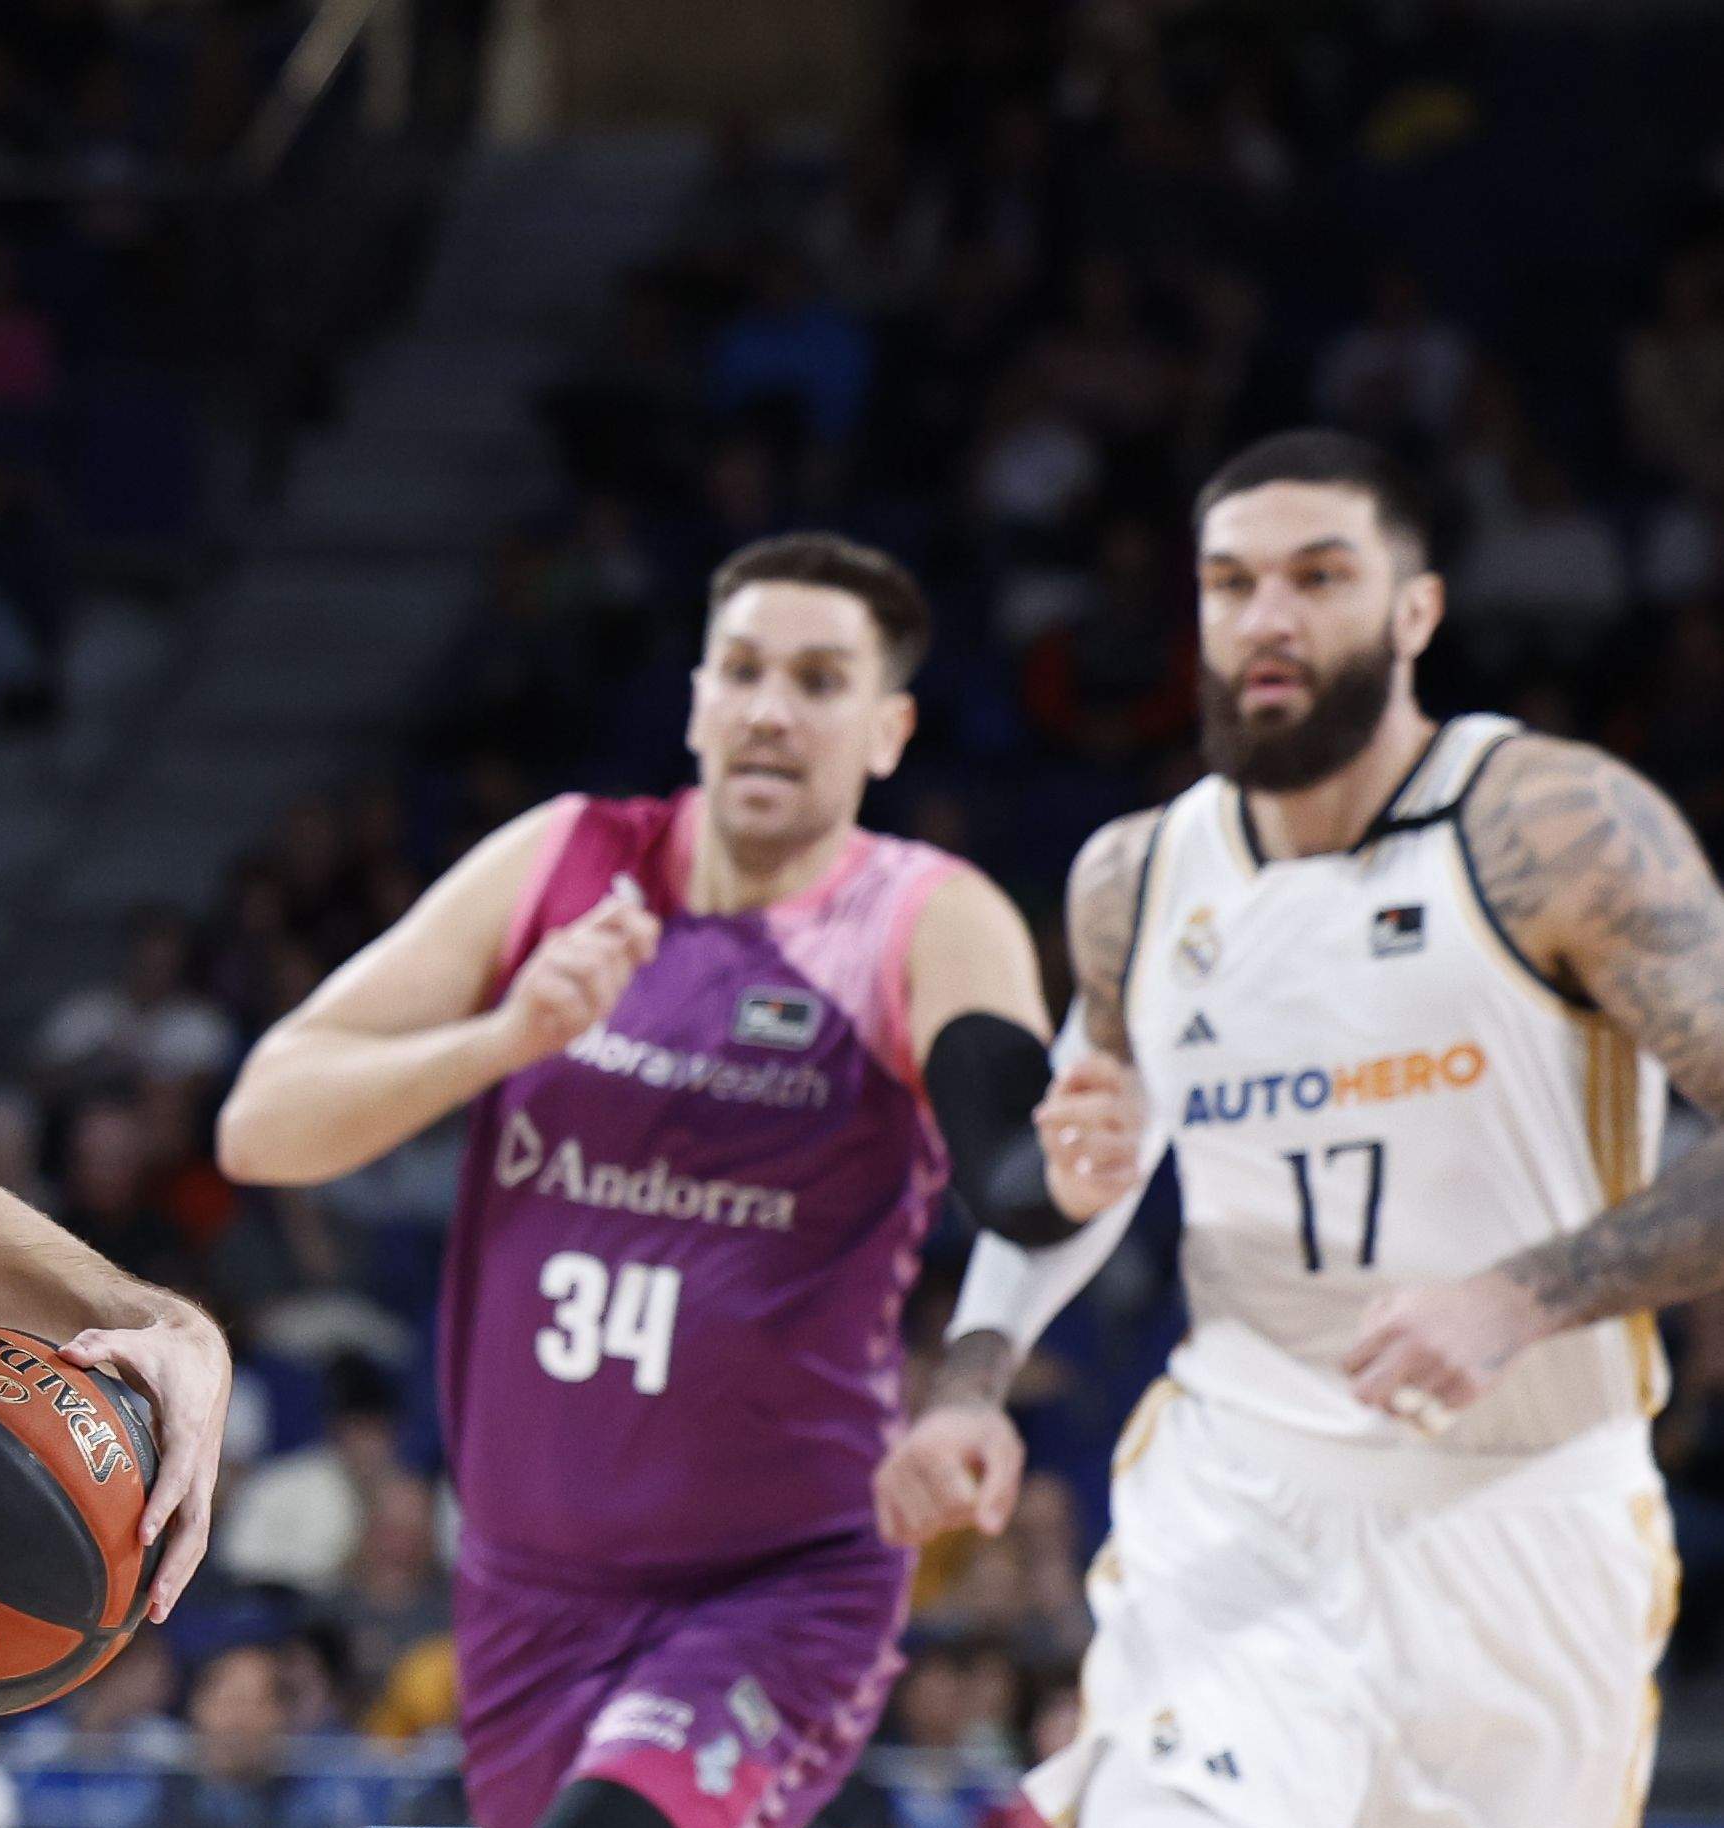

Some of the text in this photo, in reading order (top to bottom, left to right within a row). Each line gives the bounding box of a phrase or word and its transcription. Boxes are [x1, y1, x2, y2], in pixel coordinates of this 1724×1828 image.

[1181, 1042, 1487, 1127] AUTOHERO
[537, 1138, 799, 1233] Andorra
[1281, 1140, 1385, 1274] 17
[535, 1251, 683, 1396] 34
